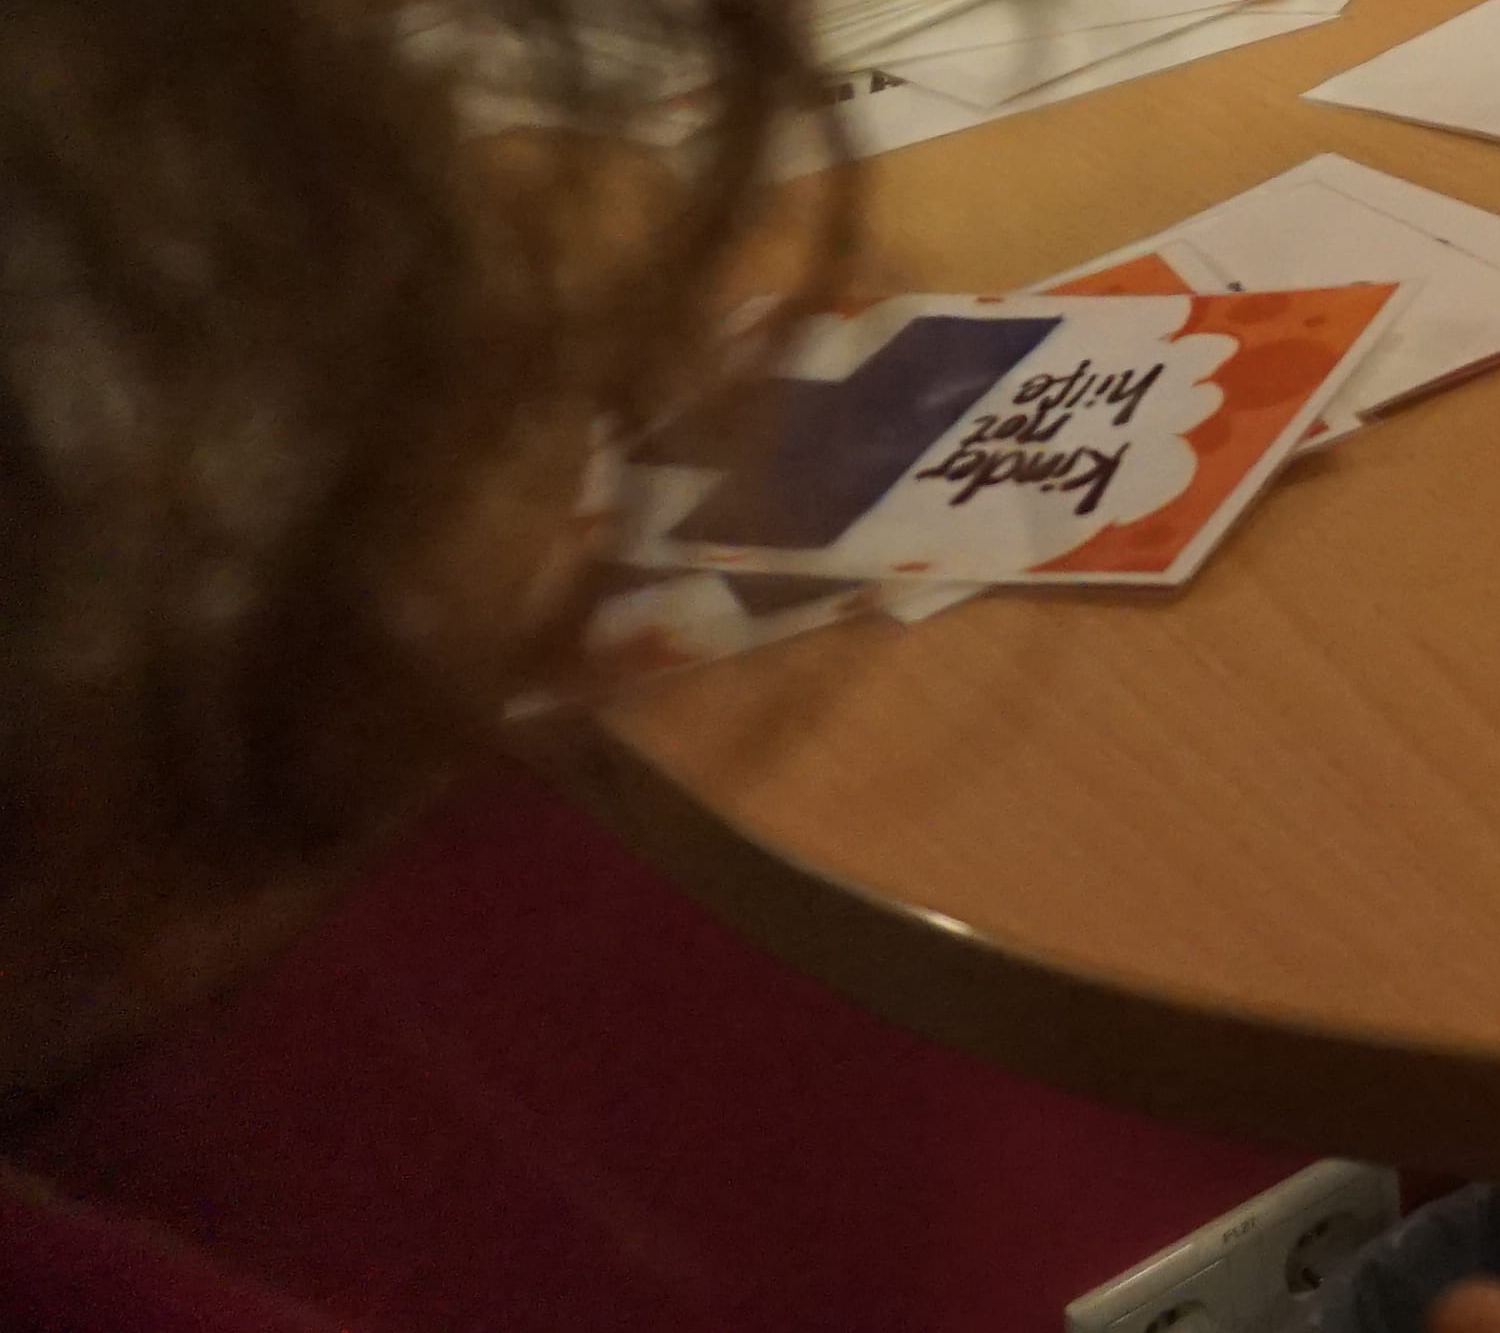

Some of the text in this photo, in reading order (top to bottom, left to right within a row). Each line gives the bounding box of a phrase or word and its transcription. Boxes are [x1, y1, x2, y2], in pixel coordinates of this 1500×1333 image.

[961, 405, 1074, 448] not
[1012, 358, 1165, 428] hilfe
[915, 442, 1131, 516] kinder
